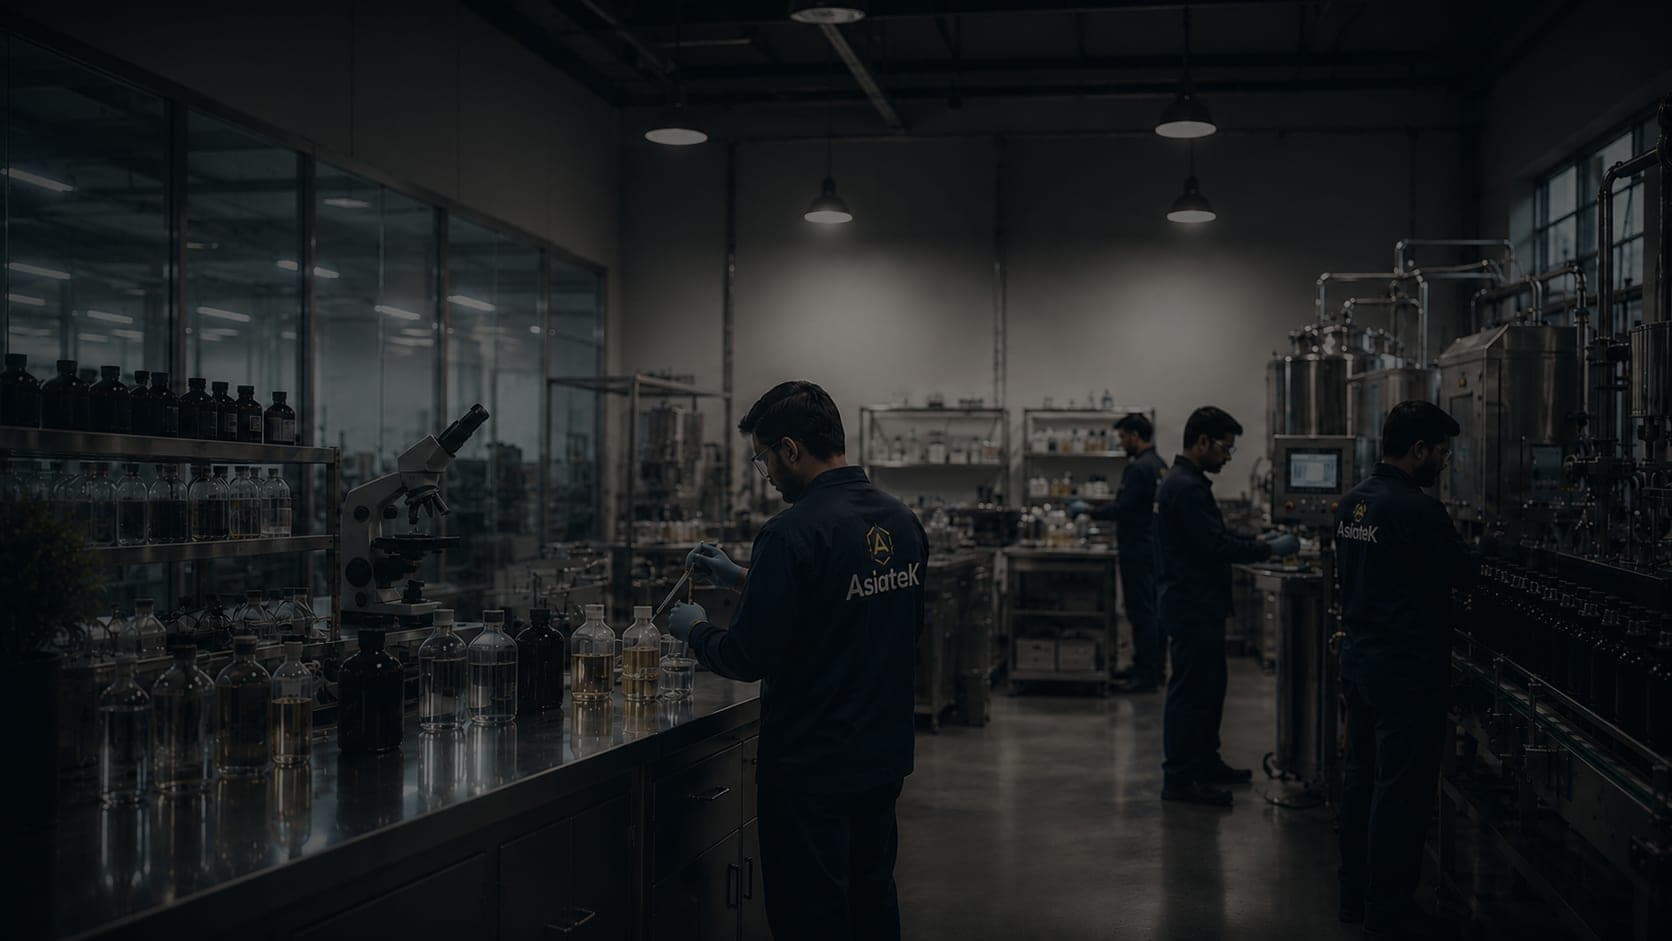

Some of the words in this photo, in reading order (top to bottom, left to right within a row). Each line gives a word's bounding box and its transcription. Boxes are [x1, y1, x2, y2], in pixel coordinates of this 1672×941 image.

[1336, 520, 1379, 543] AsiateK
[873, 533, 890, 555] A
[846, 562, 920, 600] AsiateK
